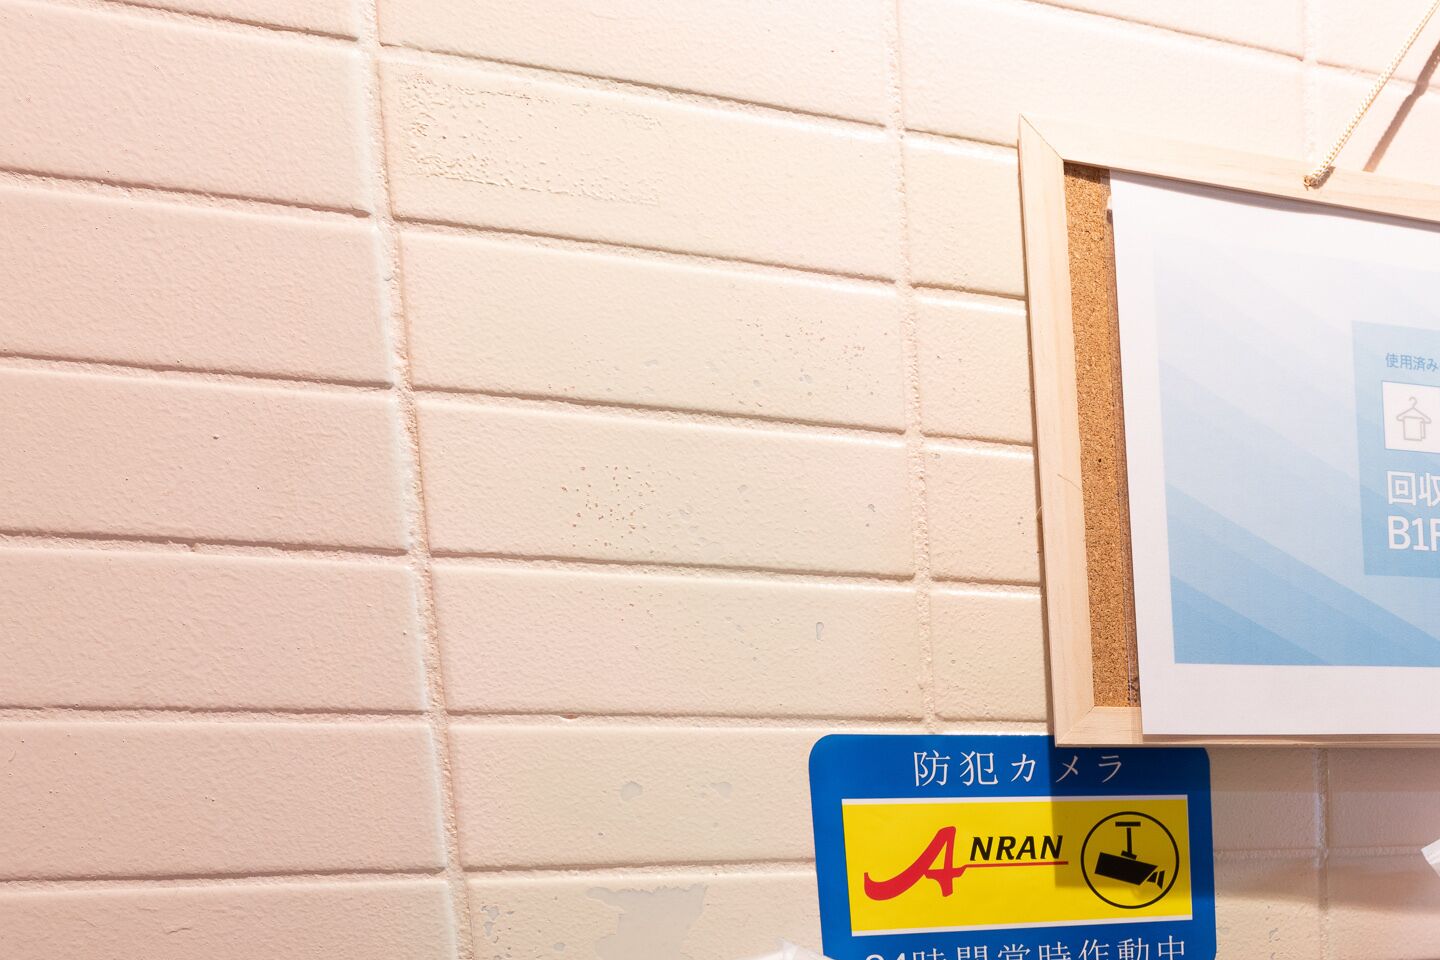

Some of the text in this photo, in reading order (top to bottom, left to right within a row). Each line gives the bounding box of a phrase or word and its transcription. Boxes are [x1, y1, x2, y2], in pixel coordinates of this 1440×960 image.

[913, 750, 1123, 787] 防犯カメラ
[863, 826, 1069, 900] ANRAN
